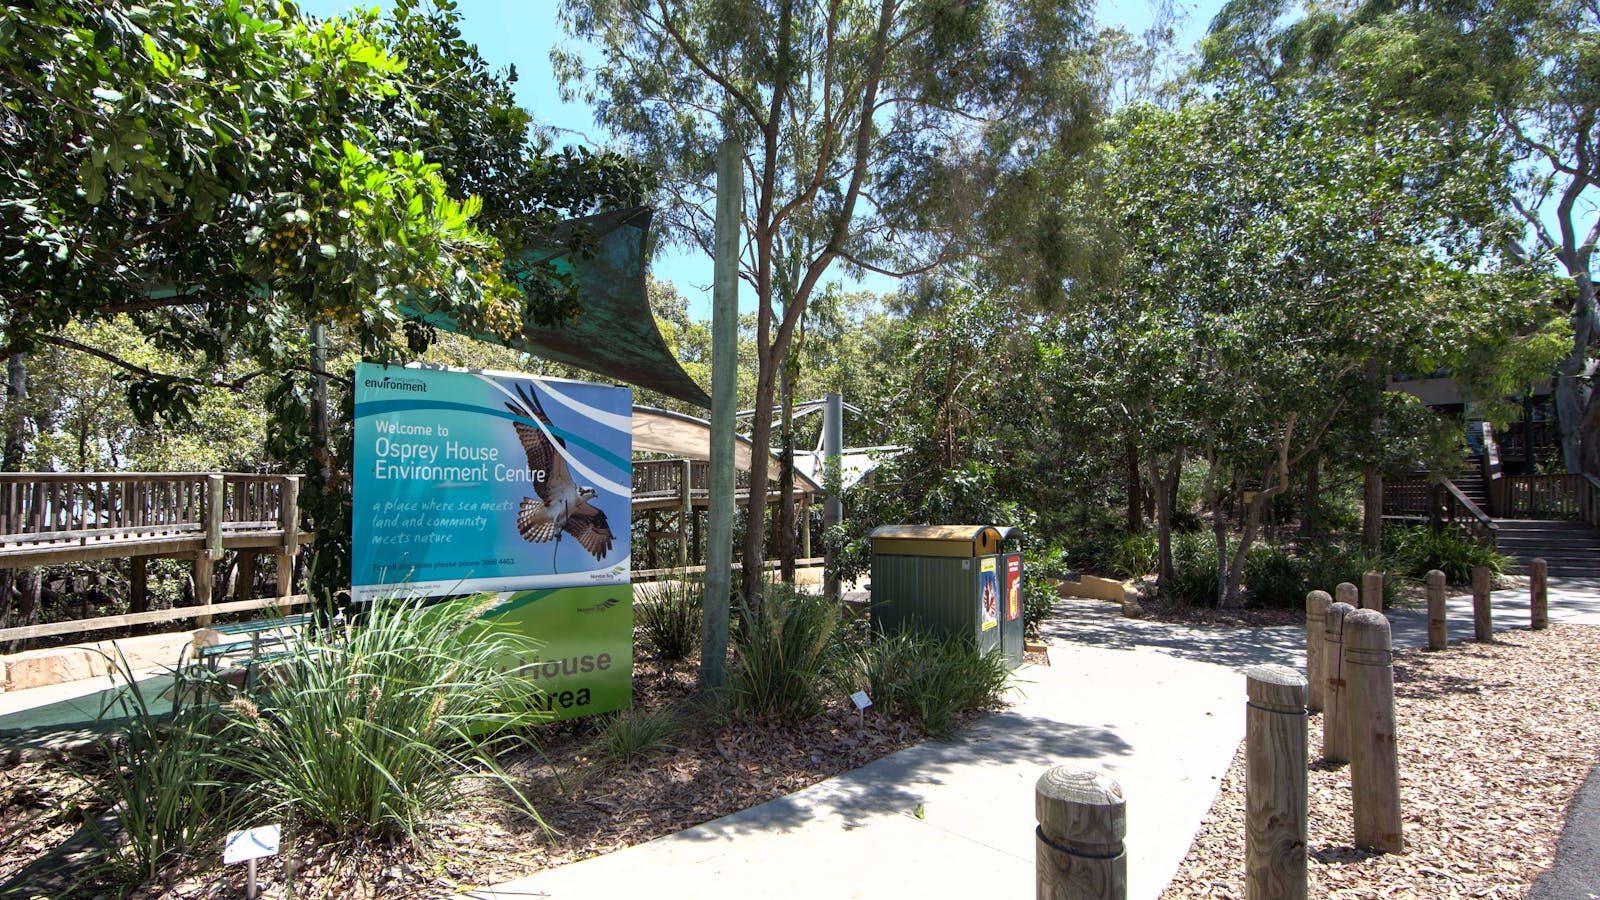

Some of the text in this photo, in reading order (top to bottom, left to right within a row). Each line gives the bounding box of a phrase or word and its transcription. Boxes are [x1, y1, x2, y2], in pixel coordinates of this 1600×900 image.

[365, 379, 427, 392] environment
[375, 420, 449, 437] Welcome to
[375, 437, 499, 464] Osprey House
[375, 459, 546, 482] Environment Centre
[372, 498, 515, 514] a place where sea meets
[372, 513, 488, 531] land and community
[372, 531, 453, 545] meets nature
[433, 561, 457, 570] please
[519, 652, 612, 680] House
[525, 687, 591, 712] Area
